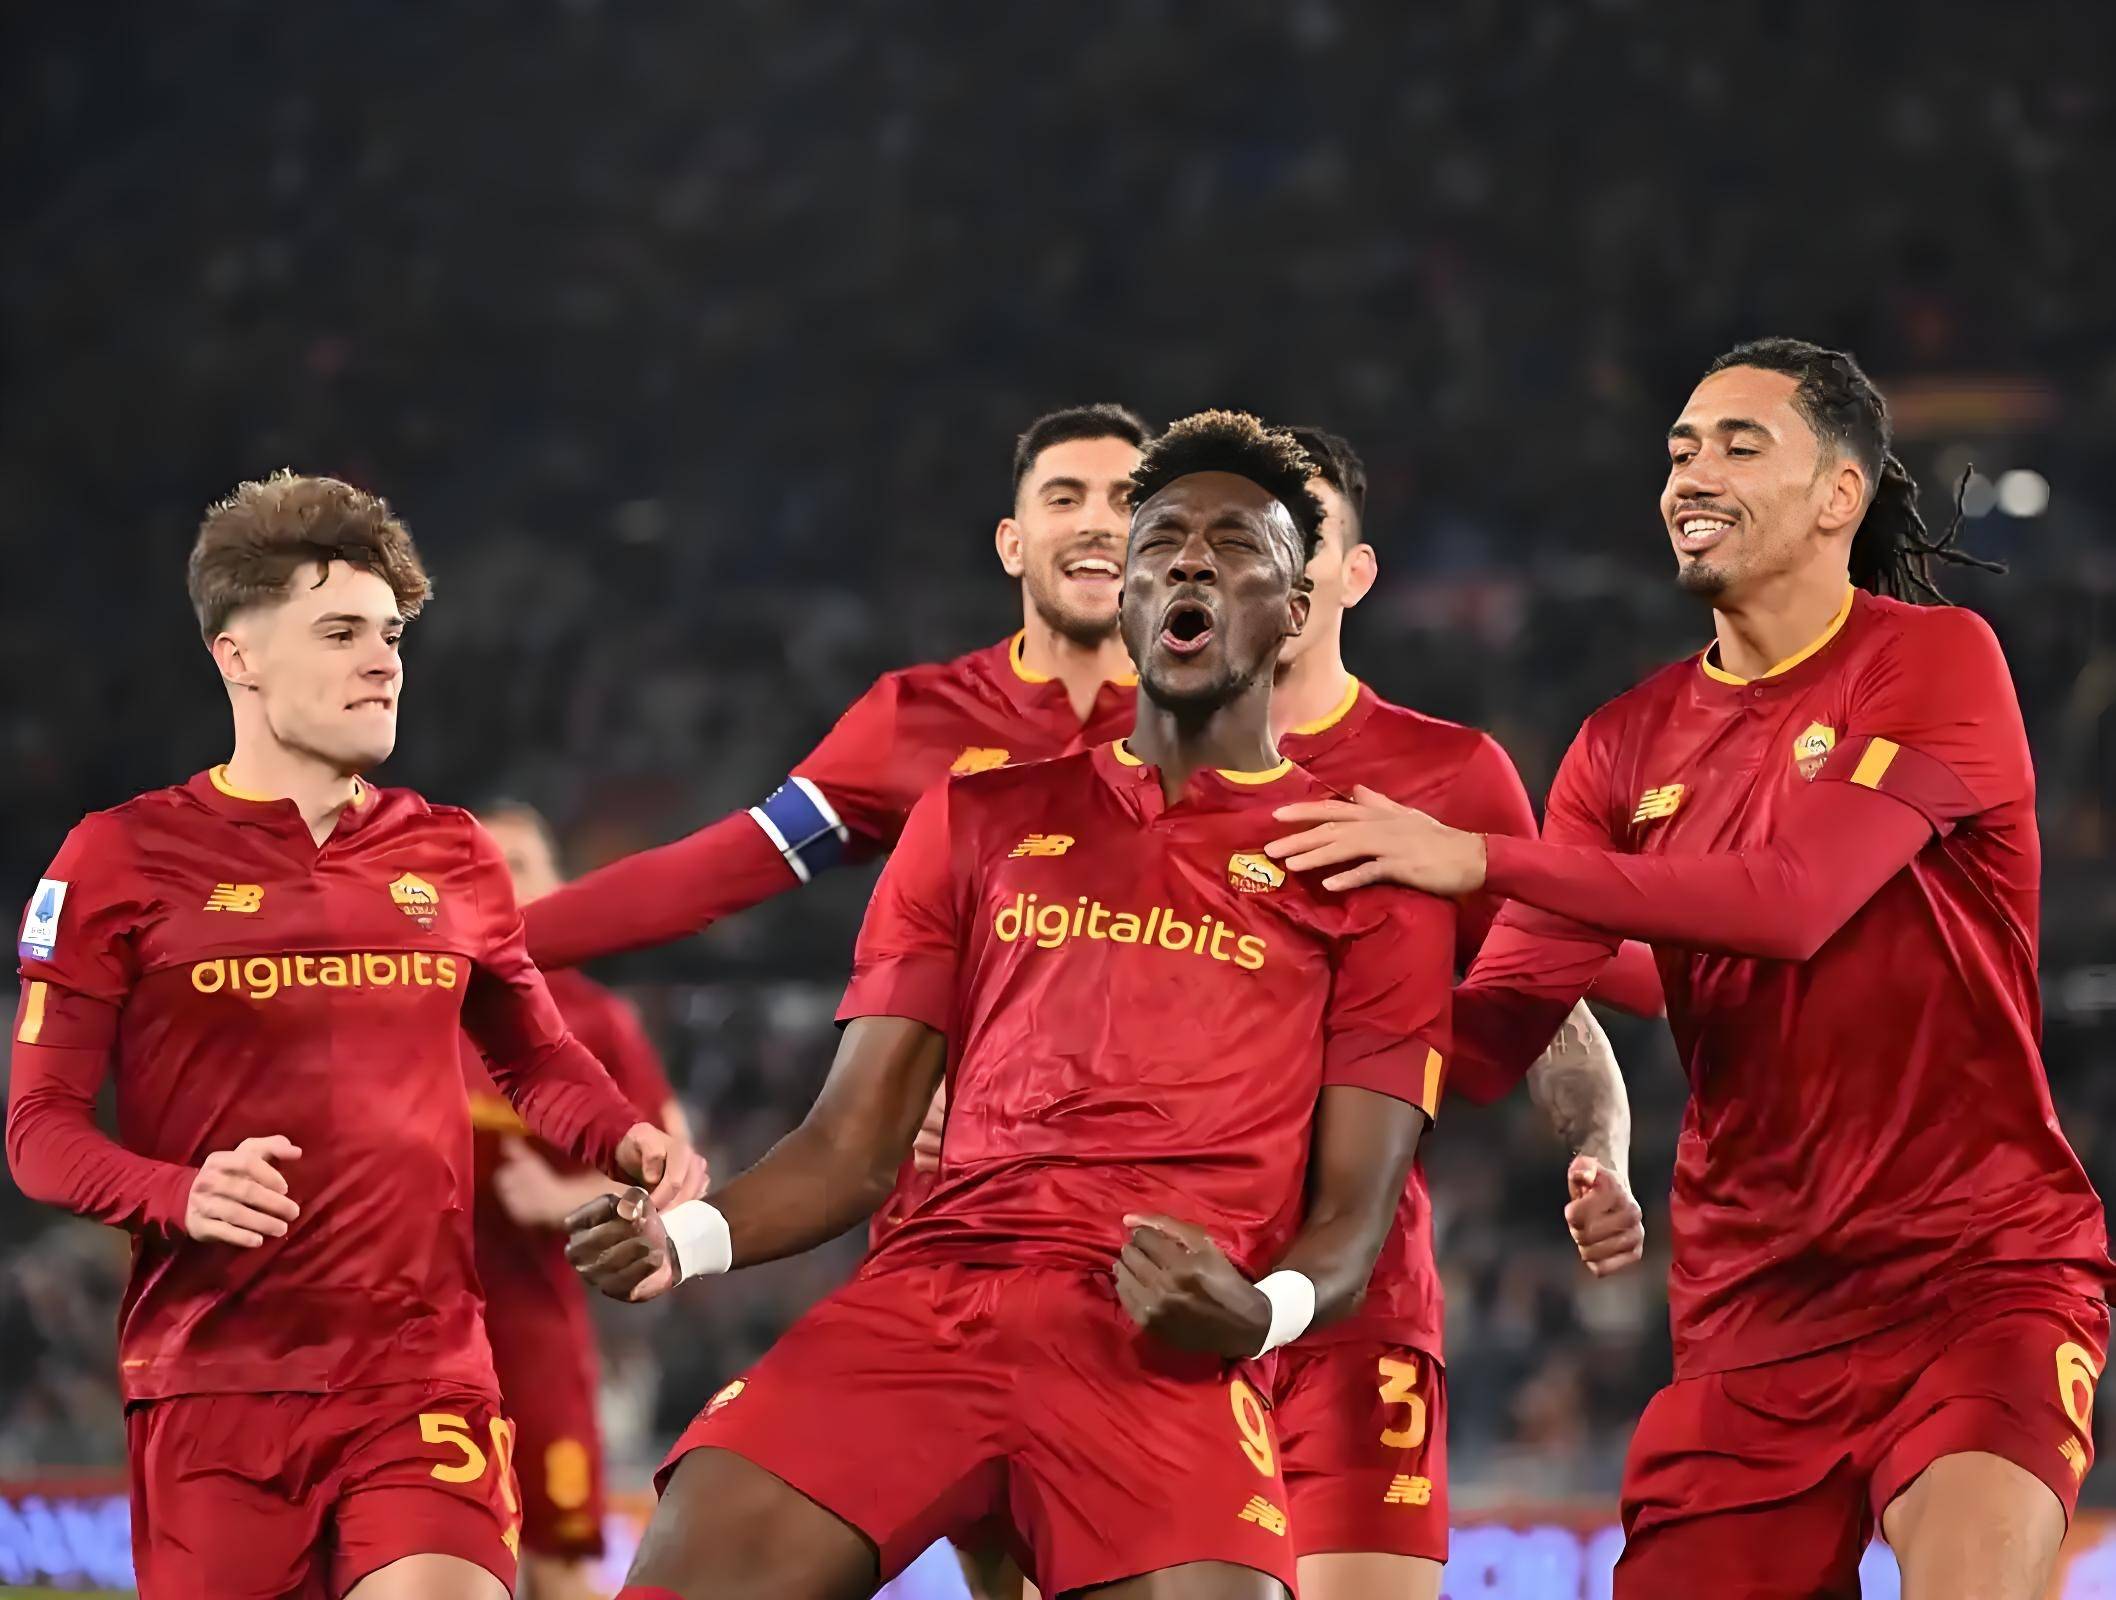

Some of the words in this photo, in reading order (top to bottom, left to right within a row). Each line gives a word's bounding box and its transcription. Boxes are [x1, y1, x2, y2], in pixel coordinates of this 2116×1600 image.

[192, 952, 457, 999] digitalbits
[995, 890, 1268, 970] digitalbits
[1230, 1379, 1276, 1478] 9
[1378, 1357, 1427, 1449] 3
[2055, 1341, 2101, 1434] 6
